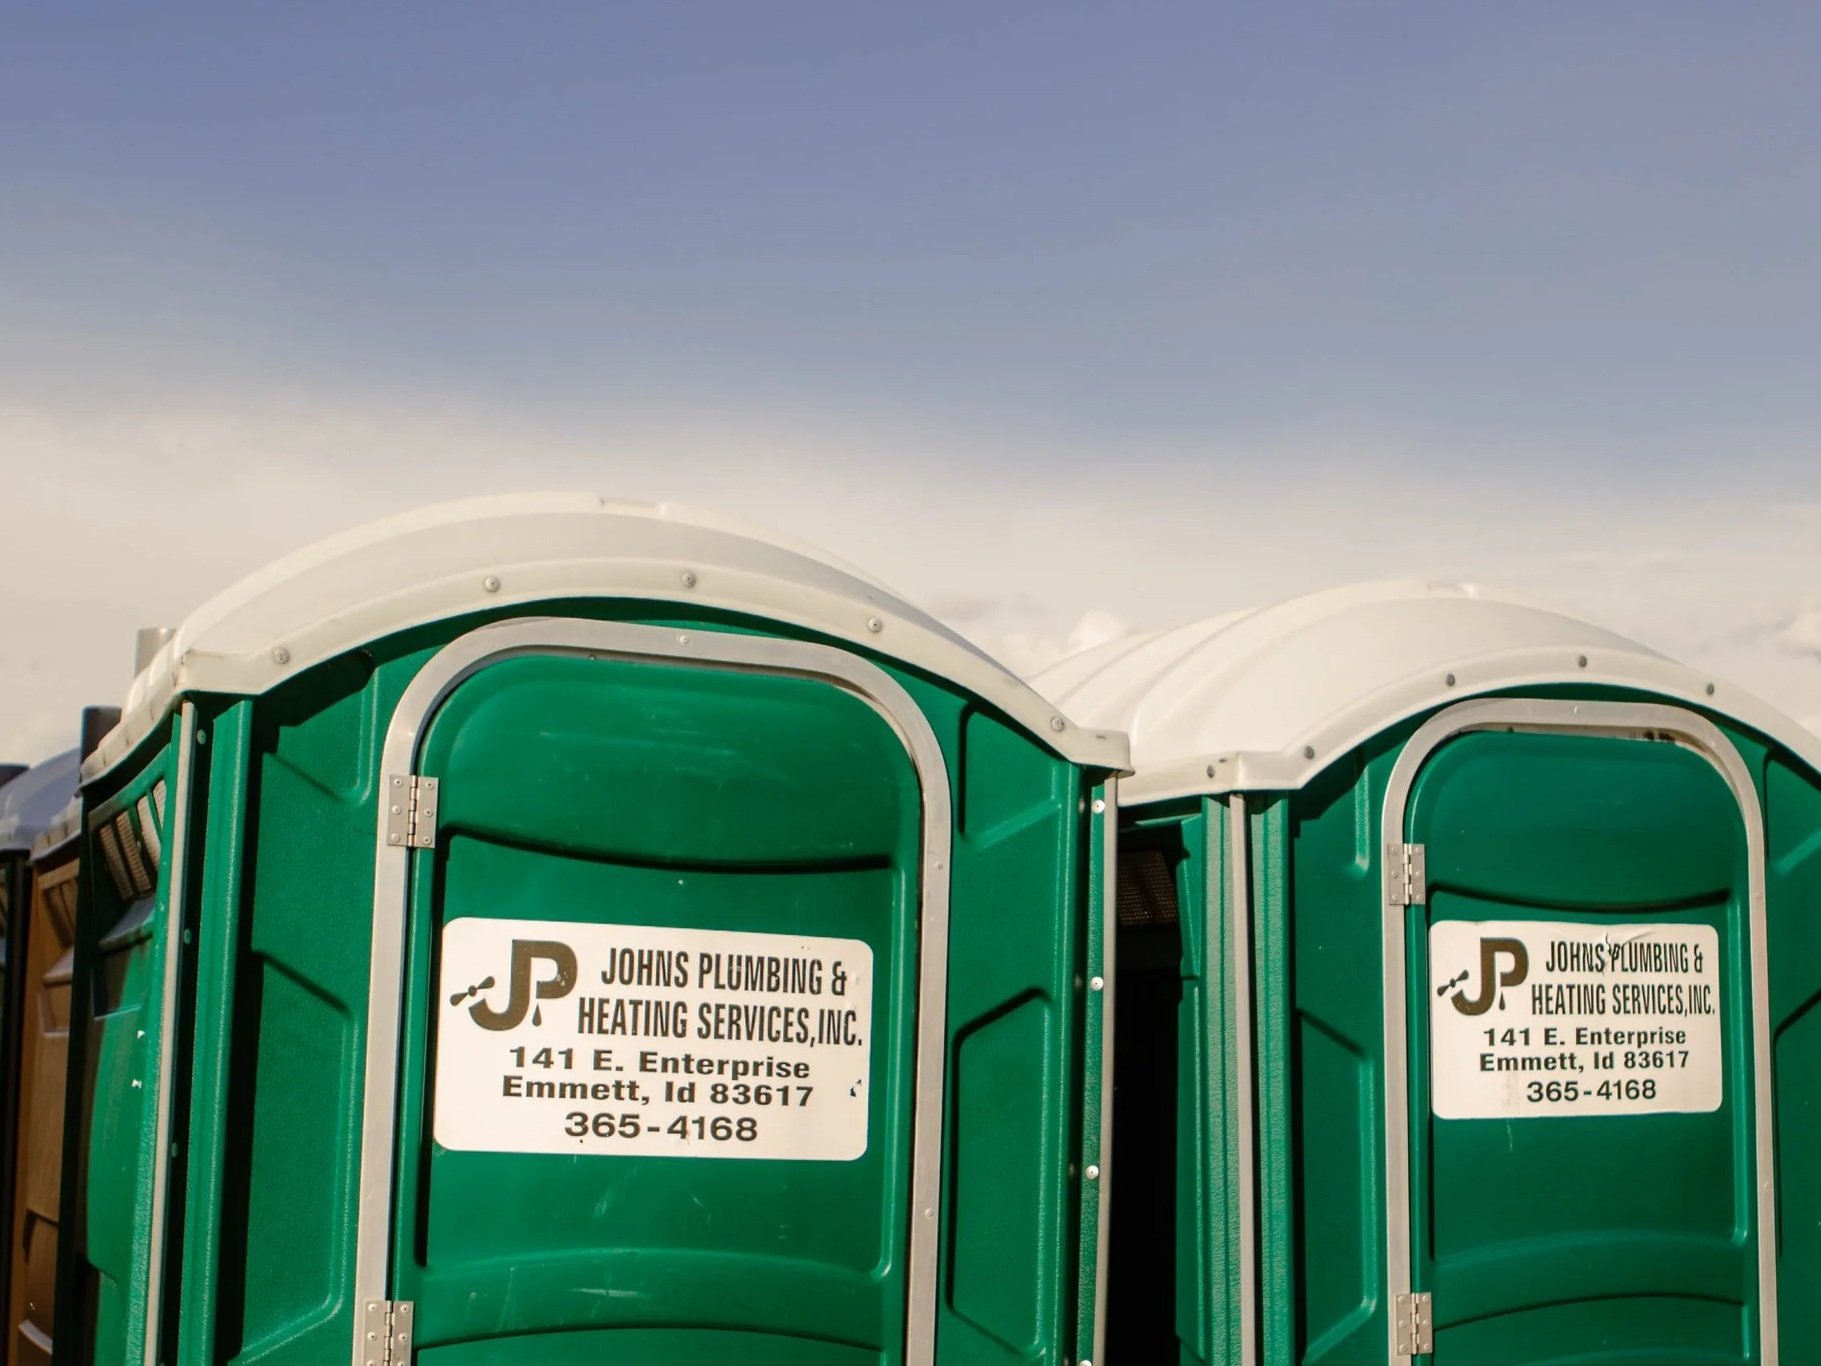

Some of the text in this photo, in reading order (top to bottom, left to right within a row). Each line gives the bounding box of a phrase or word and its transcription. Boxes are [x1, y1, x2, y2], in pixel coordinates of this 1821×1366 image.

[601, 948, 847, 996] JOHNS PLUMBING &
[1546, 941, 1703, 972] JOHNS PLUMBING &
[468, 939, 578, 1031] JP
[1450, 937, 1529, 1016] JP
[1531, 984, 1605, 1015] HEATING
[578, 997, 687, 1039] HEATING
[1483, 1027, 1686, 1047] 141 E. Enterprise
[509, 1046, 810, 1081] 141 E. Enterprise
[1480, 1051, 1689, 1072] Emmett, Id 83617
[502, 1076, 813, 1107] Emmett, Id 83617
[1527, 1080, 1656, 1102] 365-4168
[564, 1112, 758, 1142] 365-4168
